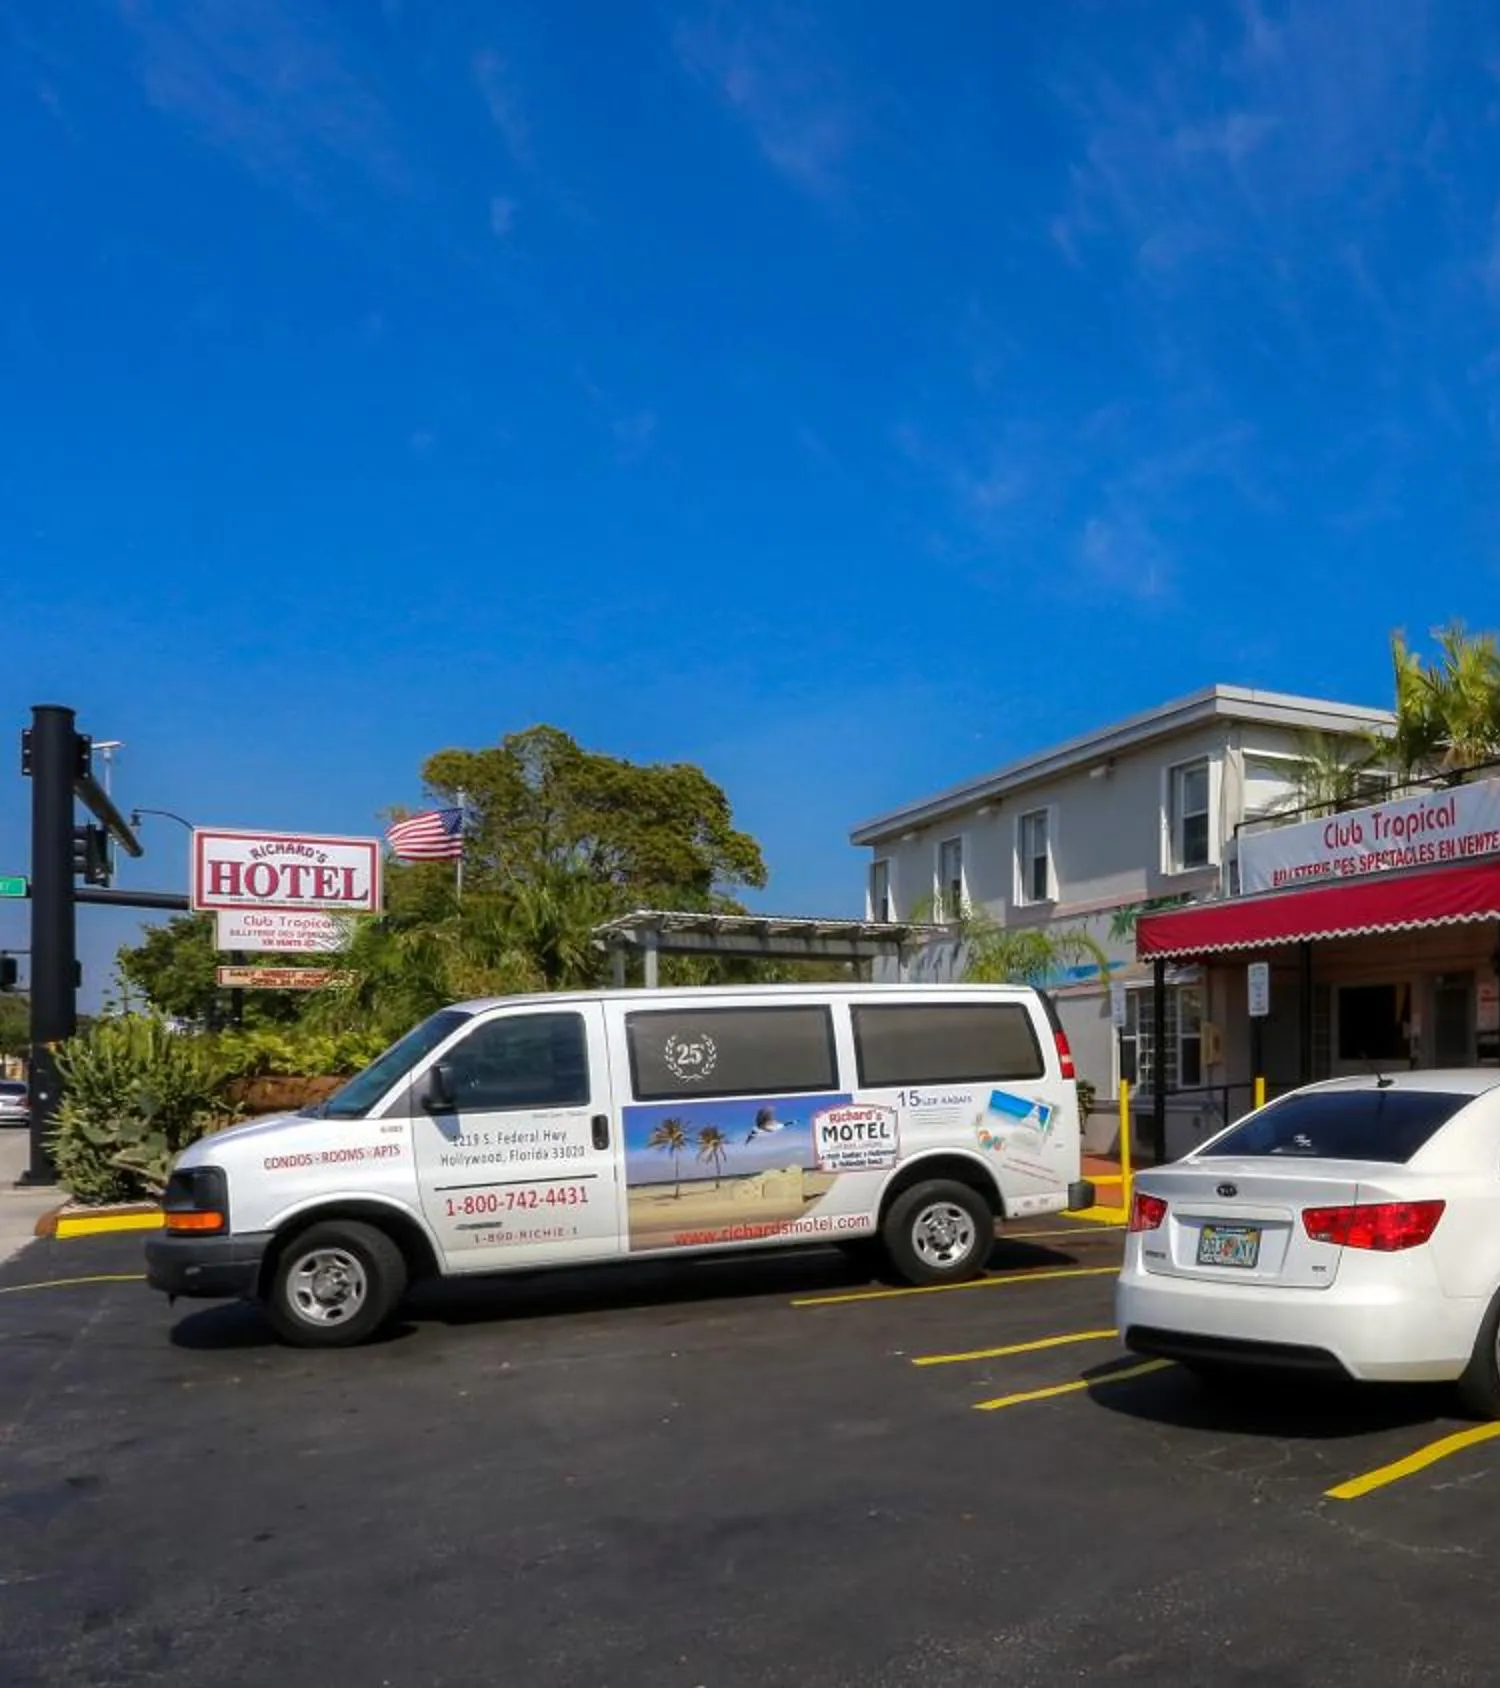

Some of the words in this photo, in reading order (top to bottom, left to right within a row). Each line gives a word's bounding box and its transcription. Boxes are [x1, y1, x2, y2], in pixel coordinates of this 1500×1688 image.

[1323, 820, 1363, 850] Club
[1371, 798, 1456, 842] Tropical
[249, 843, 329, 864] RICHARD'S
[1359, 842, 1434, 873] SPECTACLES
[1439, 840, 1455, 859] EN
[1458, 831, 1499, 856] VENTE
[207, 859, 370, 901] HOTEL
[243, 915, 273, 927] Club
[829, 1109, 883, 1123] Richard's
[452, 1133, 479, 1148] 1219
[497, 1129, 539, 1145] Federal
[543, 1129, 567, 1143] Hwy
[822, 1121, 890, 1143] MOTEL
[263, 1154, 313, 1171] CONDOS
[321, 1147, 365, 1164] ROOMS
[372, 1144, 401, 1159] APTS
[509, 1148, 549, 1162] Florida
[445, 1185, 589, 1217] 1-800-742-4431
[674, 1214, 870, 1246] www.richardsmotel.com
